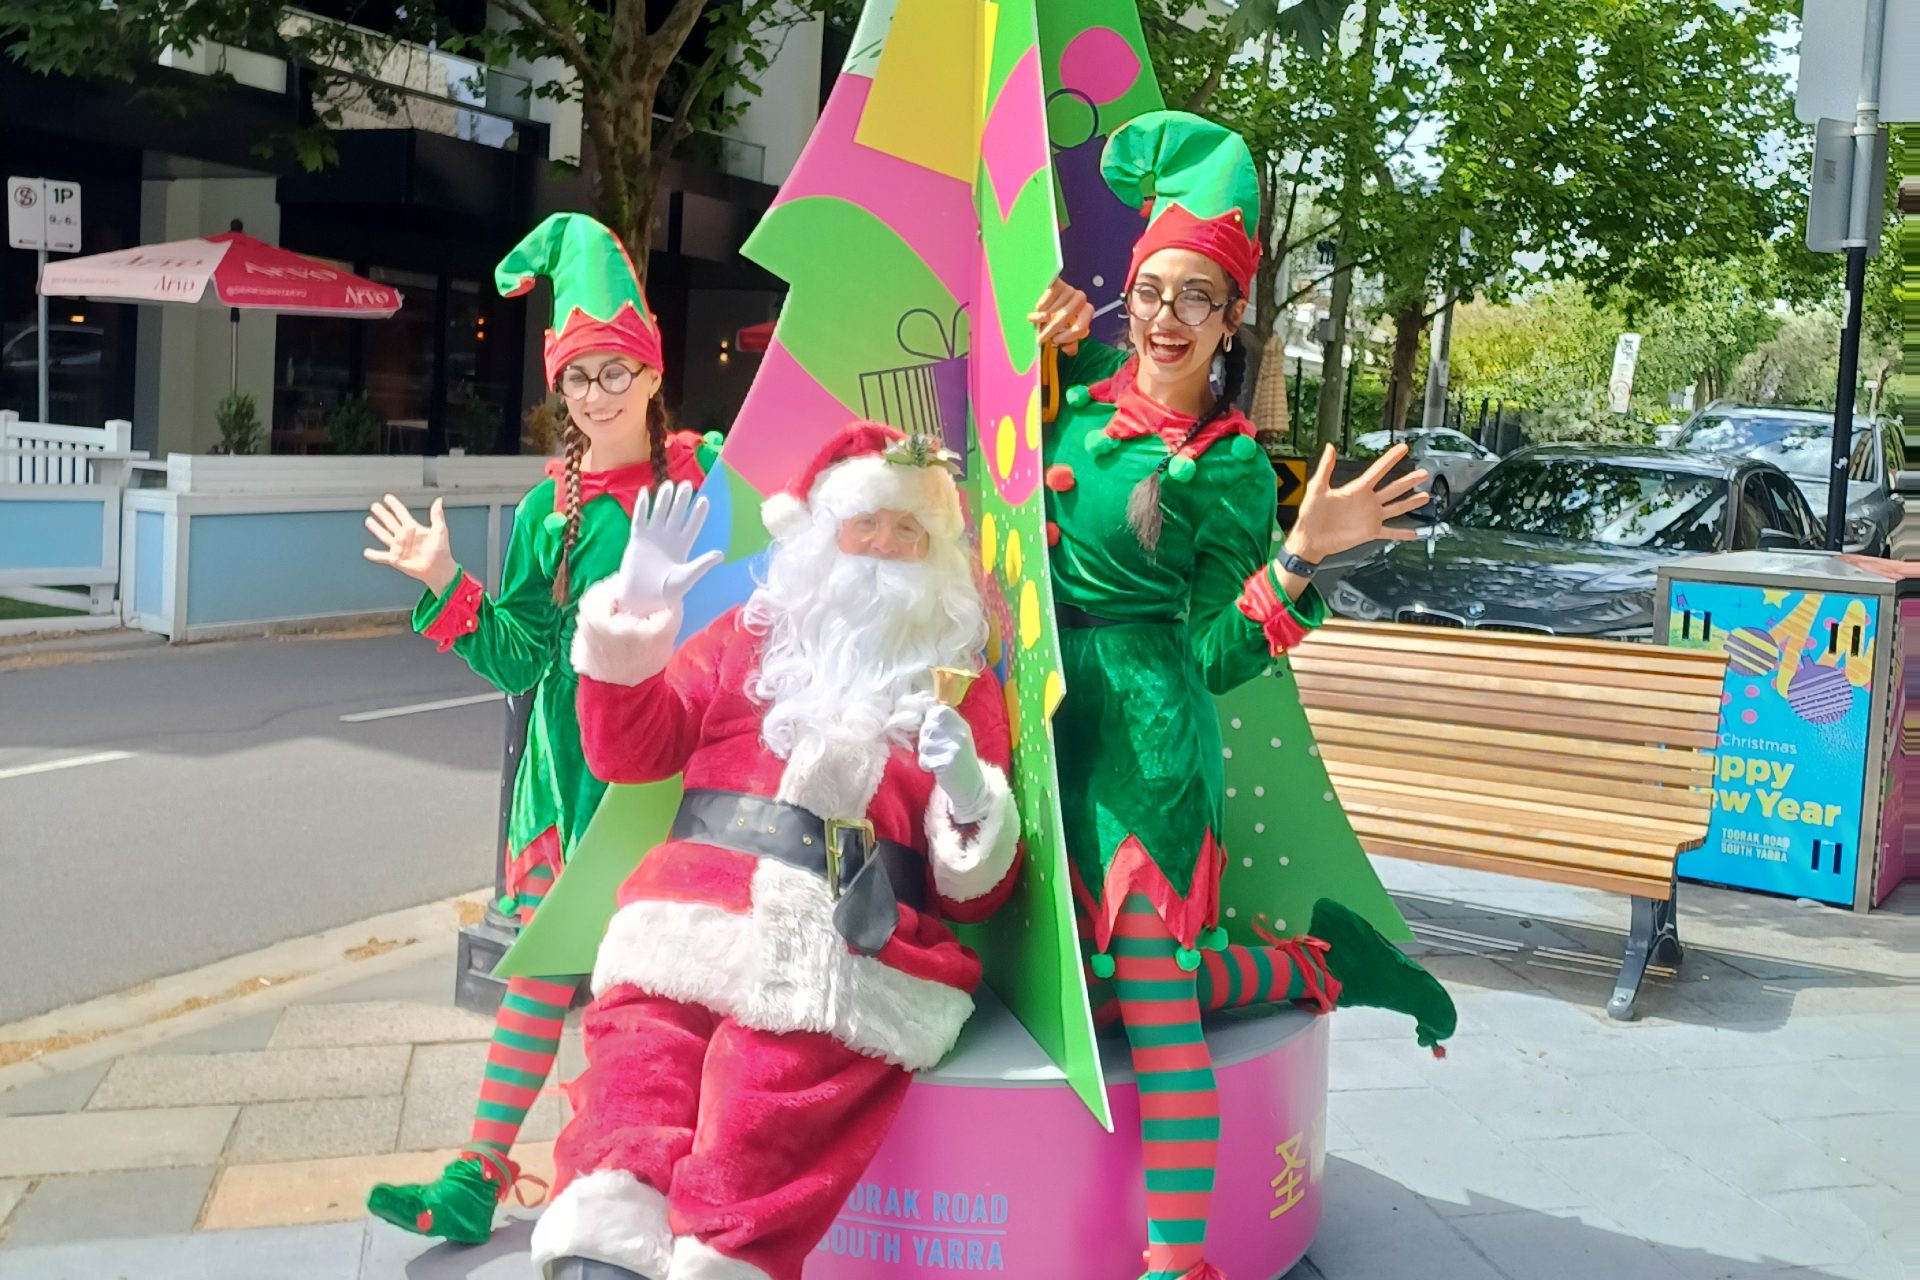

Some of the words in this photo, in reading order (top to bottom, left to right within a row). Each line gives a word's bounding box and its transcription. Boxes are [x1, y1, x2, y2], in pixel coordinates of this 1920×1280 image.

[53, 187, 74, 205] 1P
[1721, 732, 1798, 755] Christmas
[1714, 753, 1795, 790] ppy
[1755, 788, 1842, 828] Year
[1720, 841, 1753, 857] SOUTH
[1756, 847, 1788, 863] YARRA
[1722, 827, 1760, 846] TOORAK
[1763, 833, 1791, 850] ROAD
[848, 1183, 921, 1220] ORAK
[932, 1192, 1008, 1225] ROAD
[912, 1235, 1004, 1271] YARRA
